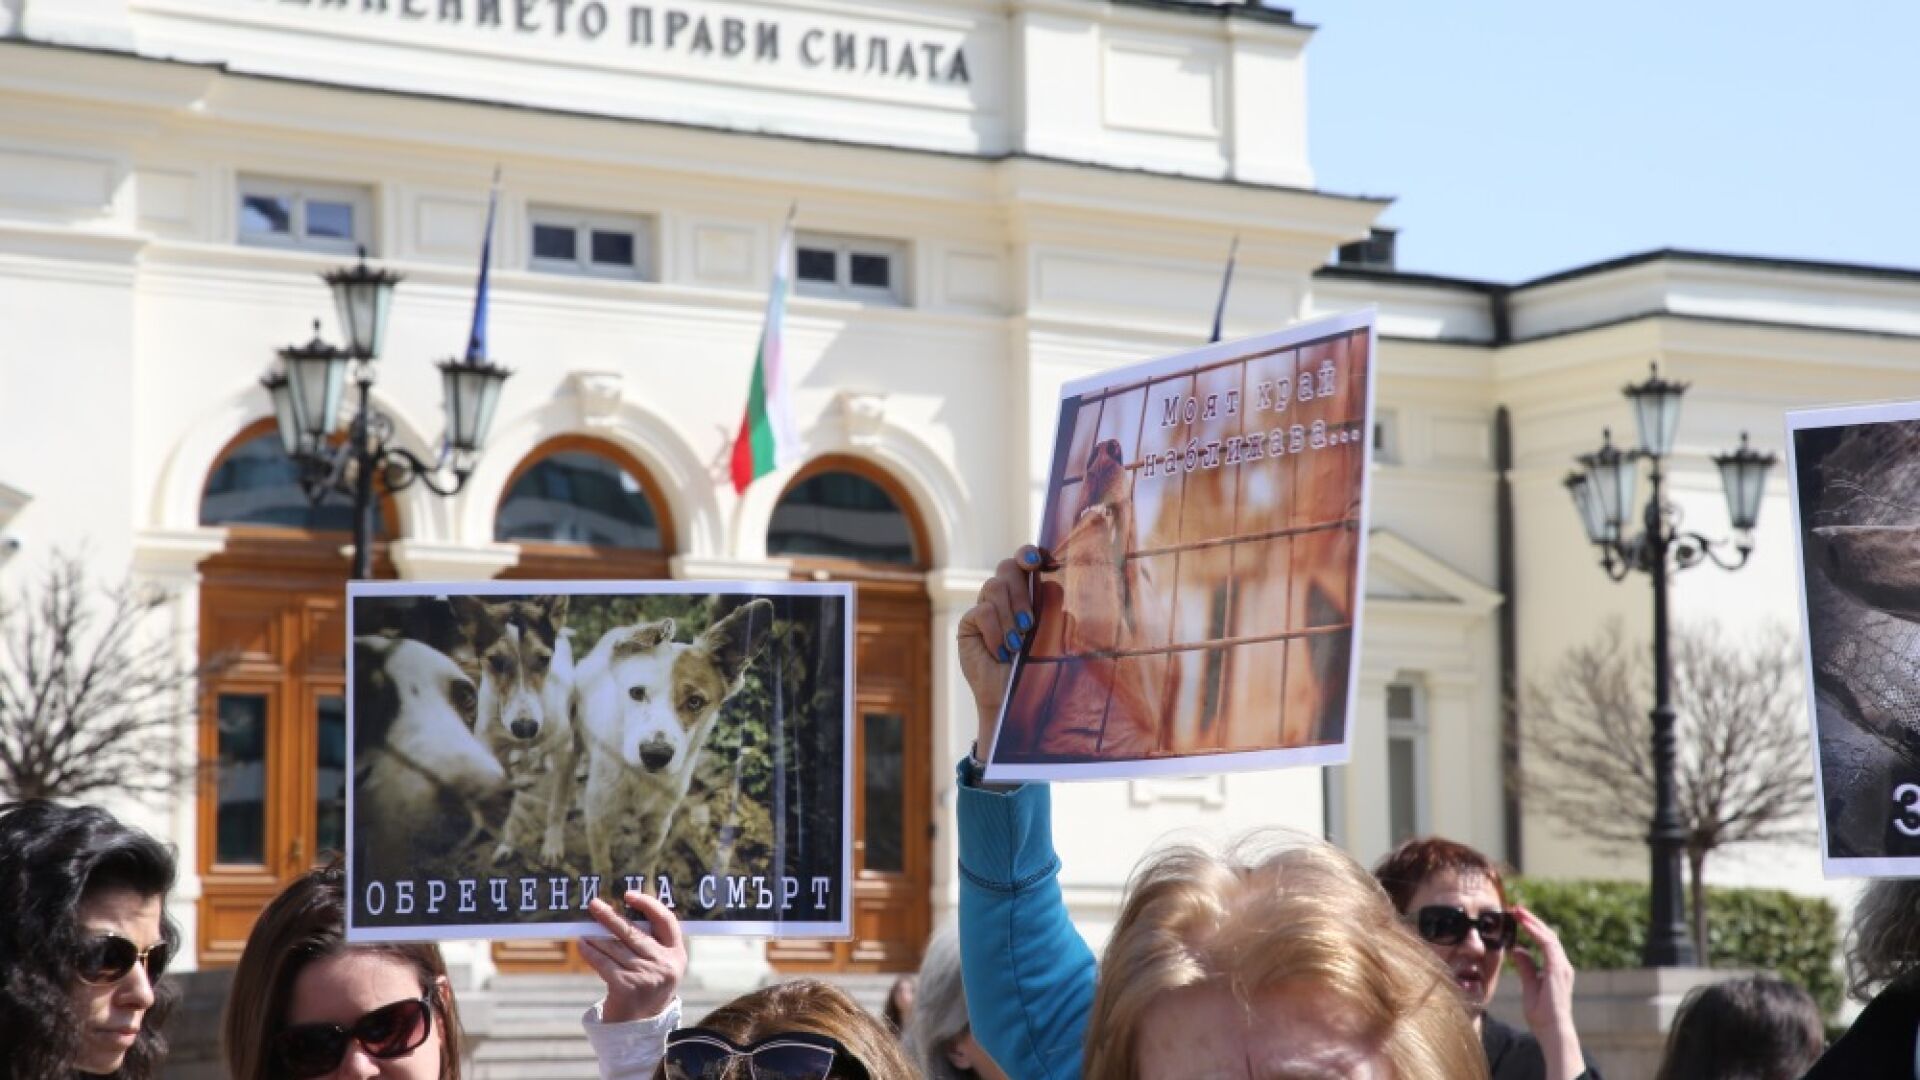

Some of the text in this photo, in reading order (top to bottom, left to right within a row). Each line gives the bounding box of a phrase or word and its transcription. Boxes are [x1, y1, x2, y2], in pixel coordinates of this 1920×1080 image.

[629, 6, 779, 61] ПРАВИ
[801, 28, 971, 83] СИЛАТА
[1161, 360, 1336, 426] Моят край
[1143, 420, 1360, 476] наближава...
[365, 875, 830, 915] ОБРЕЧЕНИ НА СМЪРТ
